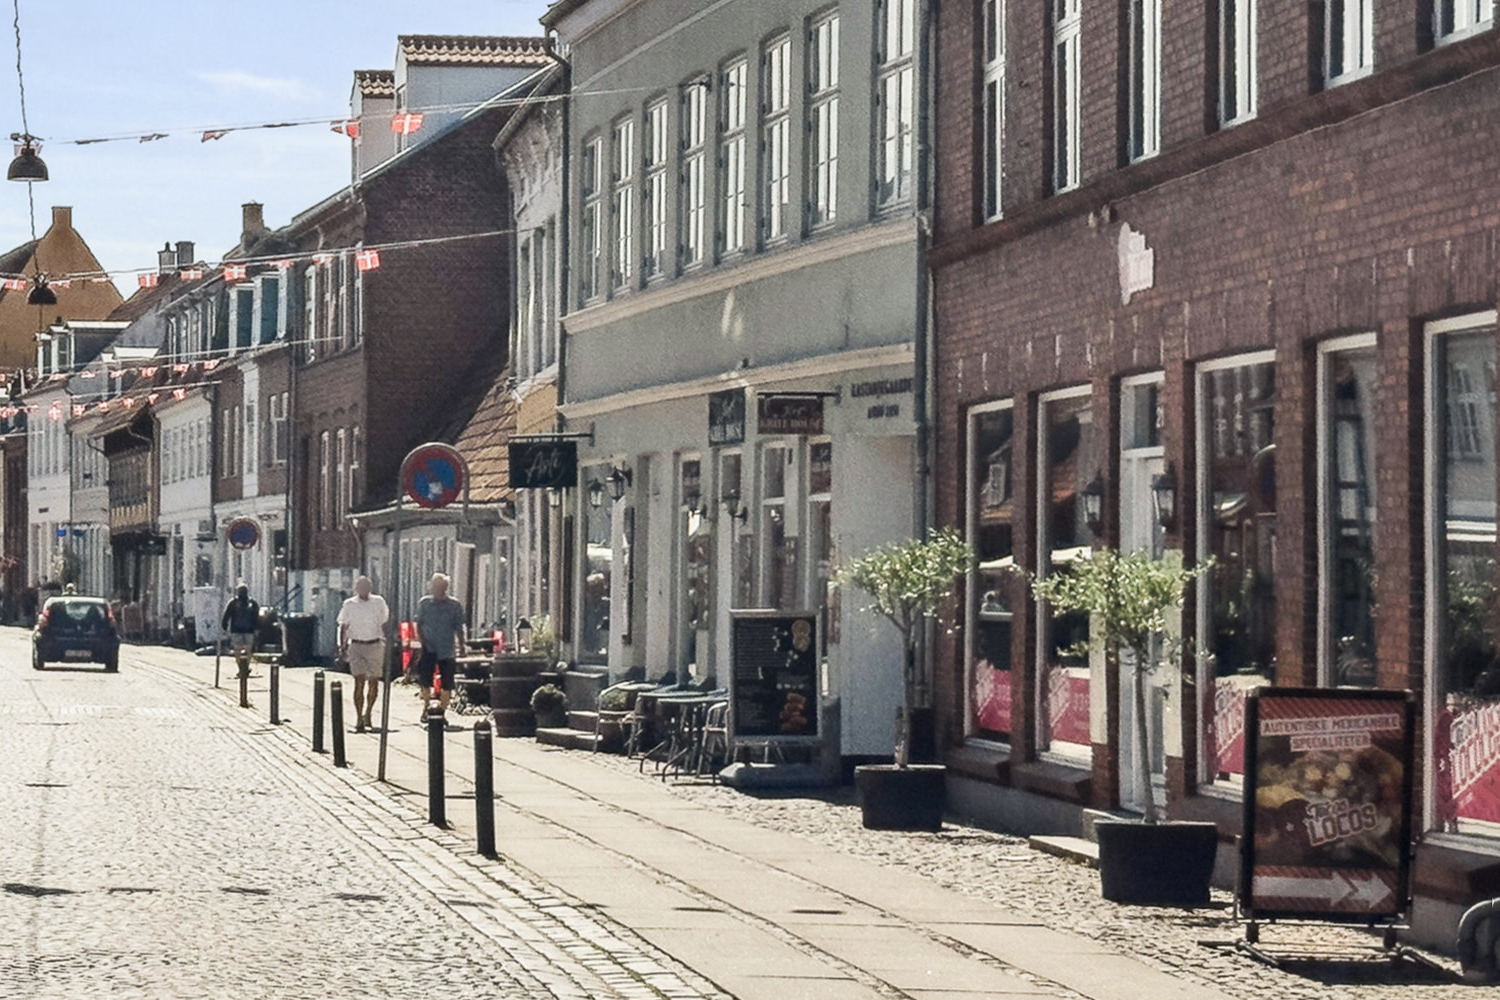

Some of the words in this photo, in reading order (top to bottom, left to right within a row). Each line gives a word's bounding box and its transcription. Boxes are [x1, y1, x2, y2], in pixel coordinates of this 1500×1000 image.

[1263, 719, 1327, 735] AUTENTISKE
[1291, 734, 1371, 749] SPECIALITETER
[1307, 805, 1377, 844] LOCOS
